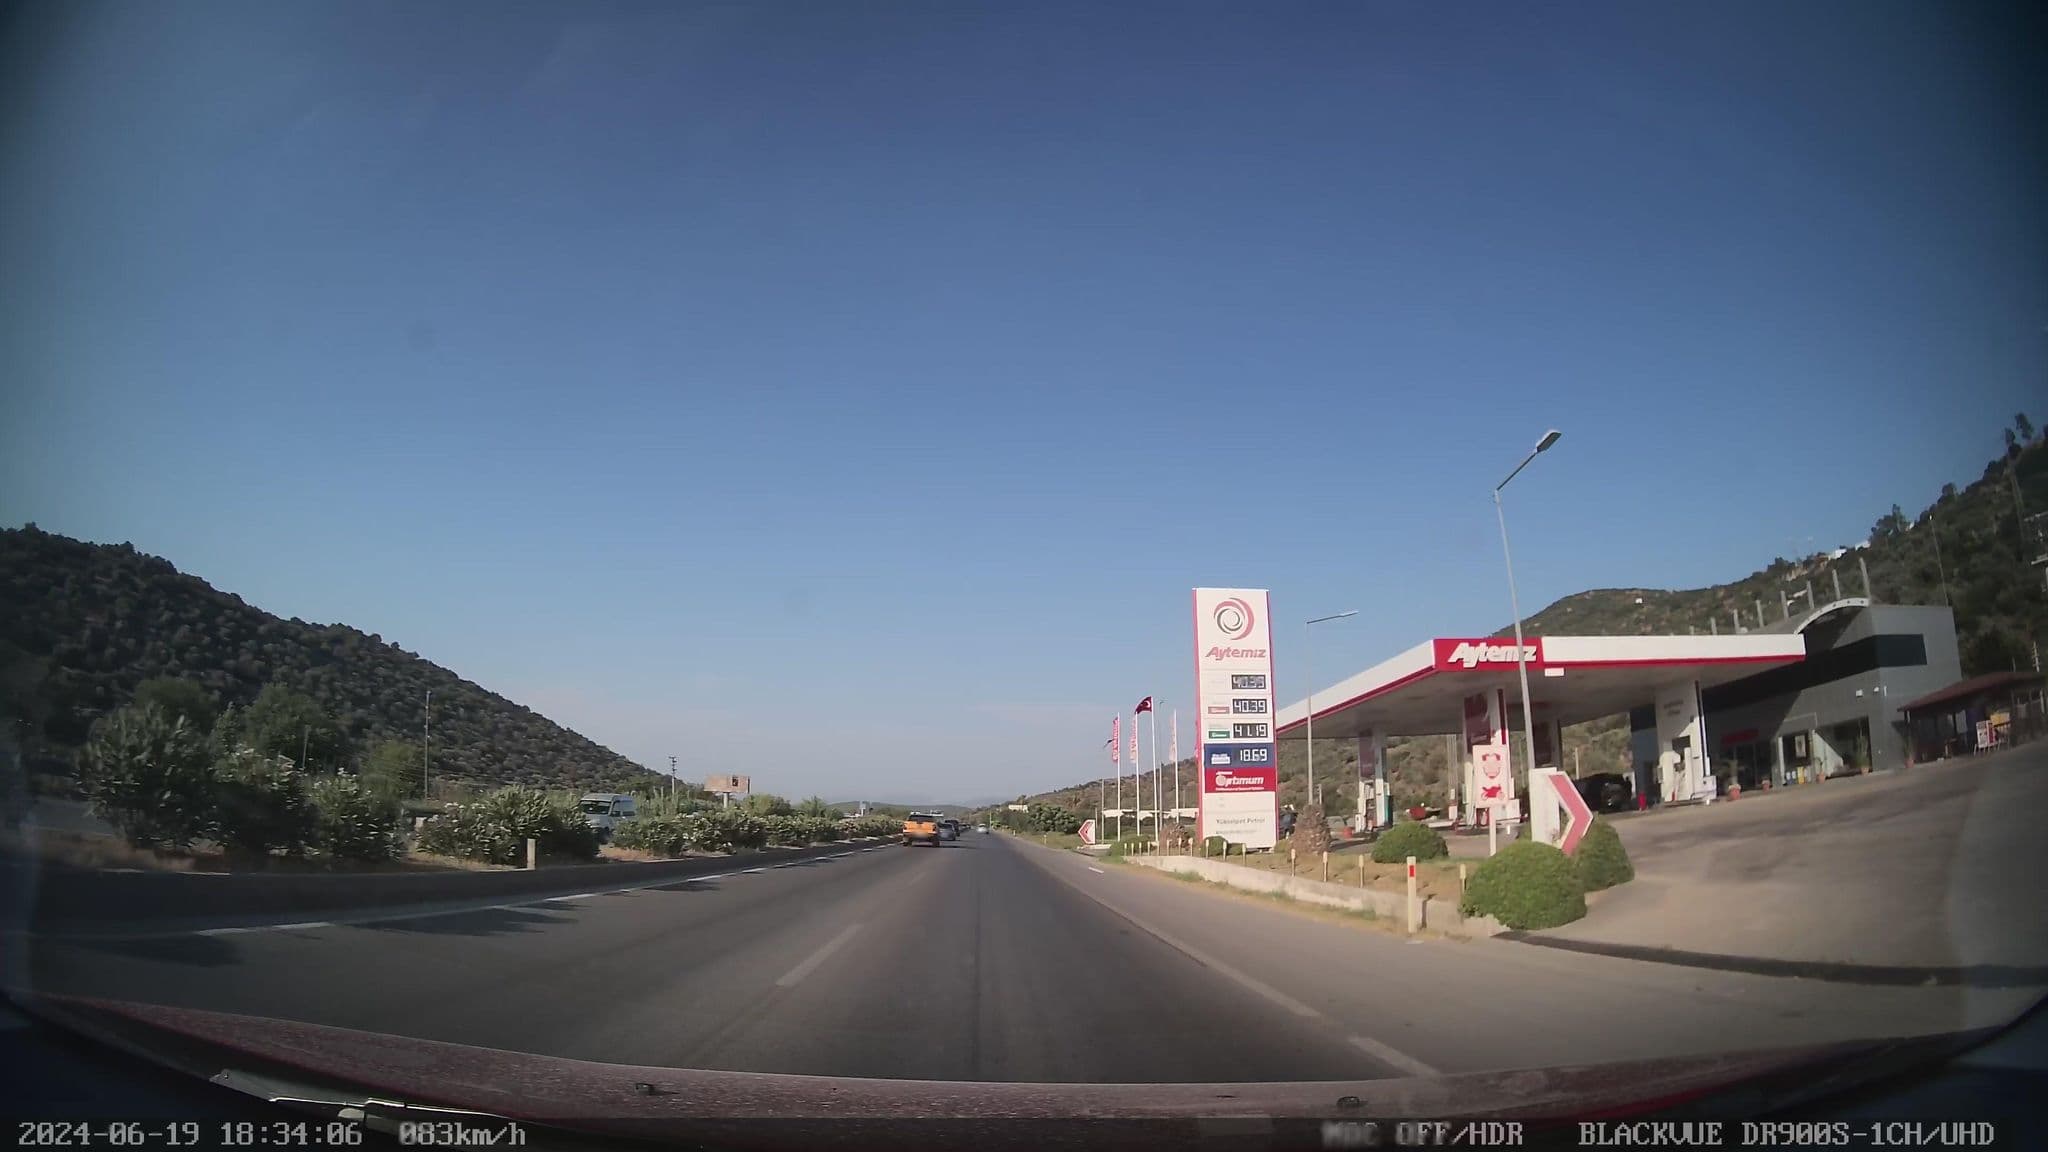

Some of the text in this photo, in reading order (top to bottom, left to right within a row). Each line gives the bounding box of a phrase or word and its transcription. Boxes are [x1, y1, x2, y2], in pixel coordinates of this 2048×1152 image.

[1447, 642, 1537, 668] Aytemz
[1234, 700, 1266, 712] 40.39
[1240, 749, 1268, 762] 18.69
